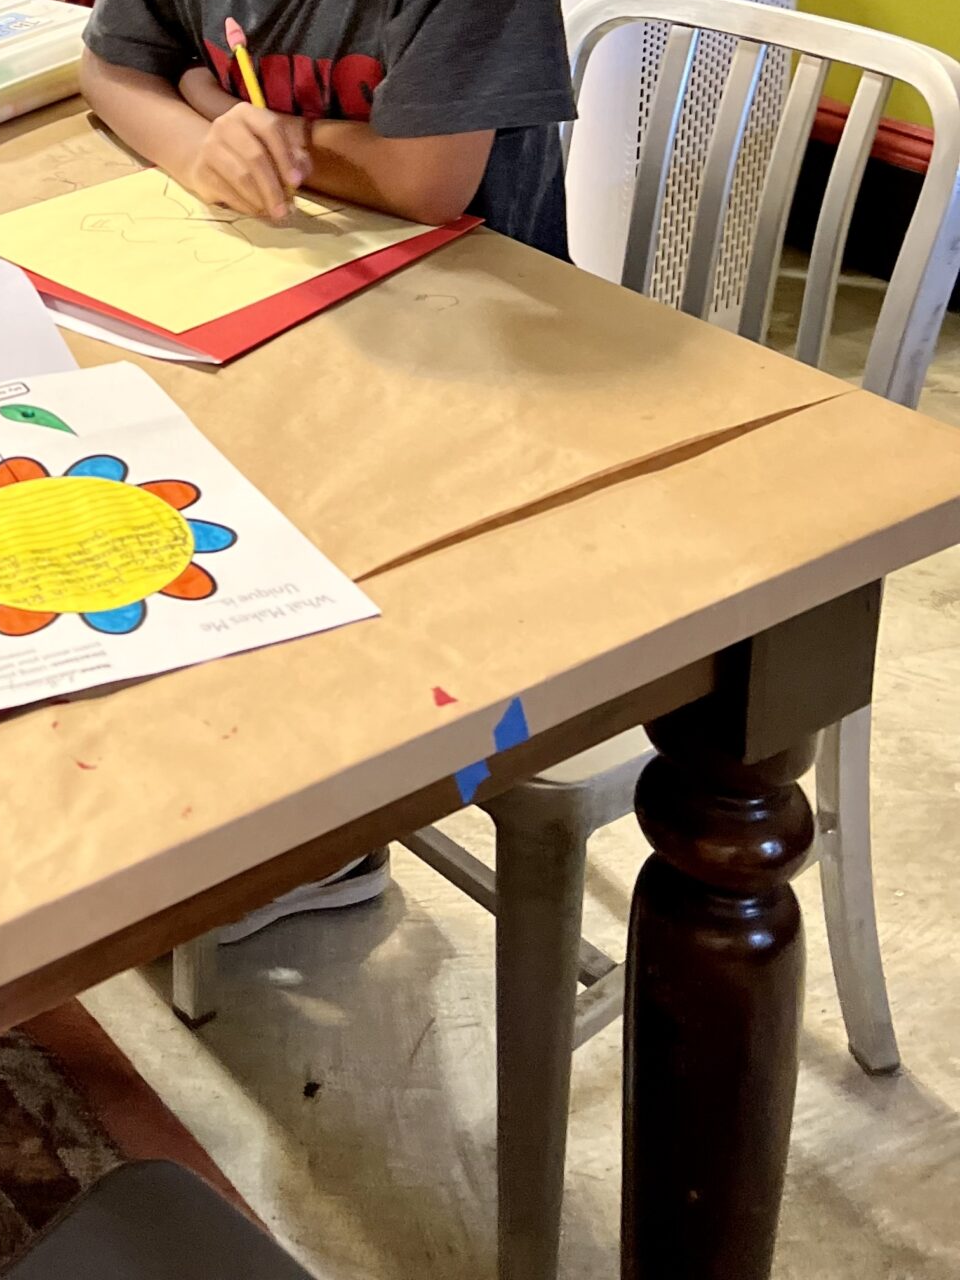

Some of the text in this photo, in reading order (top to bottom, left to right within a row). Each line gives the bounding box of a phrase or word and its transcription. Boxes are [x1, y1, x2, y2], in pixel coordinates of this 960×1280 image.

[239, 583, 300, 601] Unique
[199, 594, 336, 633] What Makes Me
